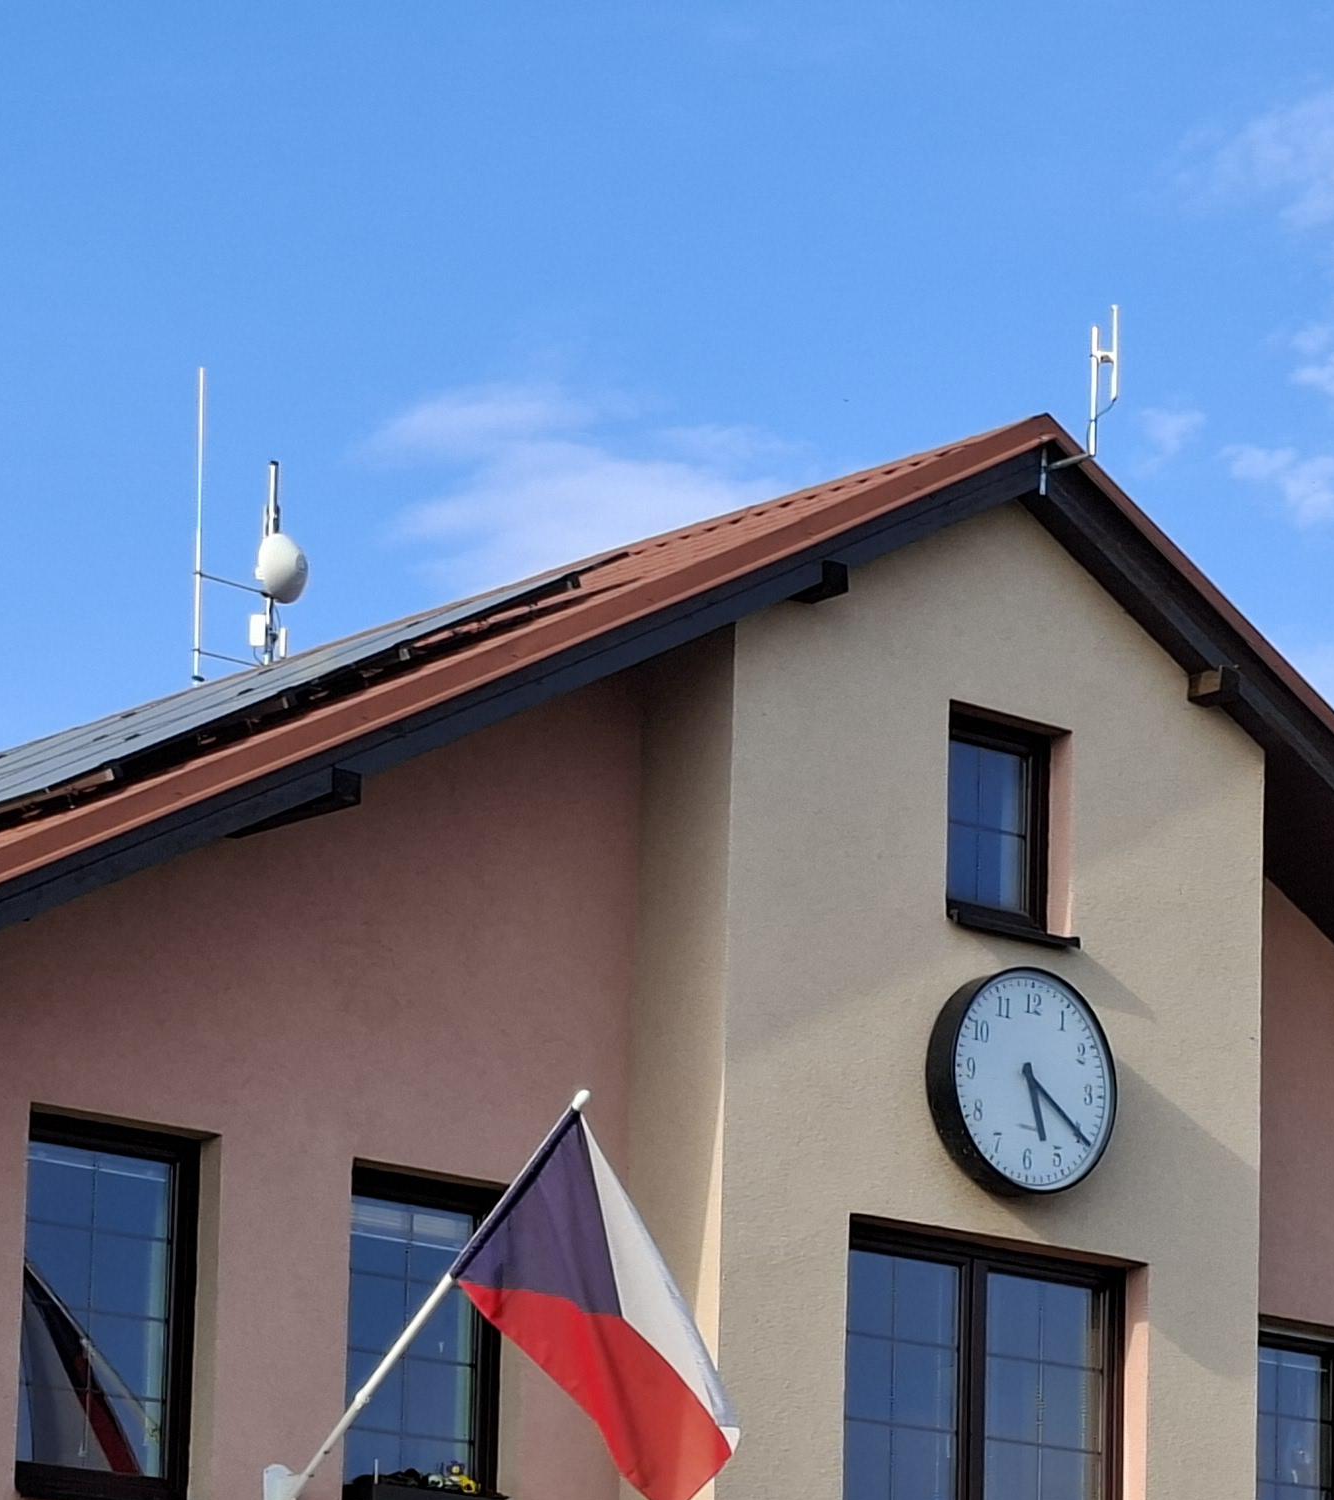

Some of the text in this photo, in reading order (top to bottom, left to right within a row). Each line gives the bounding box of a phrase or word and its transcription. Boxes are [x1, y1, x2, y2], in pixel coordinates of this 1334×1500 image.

[996, 996, 1011, 1018] 11
[1026, 993, 1042, 1016] 12
[972, 1020, 989, 1042] 10
[1058, 1010, 1065, 1031] 1
[1077, 1043, 1086, 1065] 2
[967, 1057, 976, 1079] 9
[1083, 1084, 1093, 1106] 3
[973, 1099, 983, 1121] 8
[993, 1132, 1002, 1154] 7
[1022, 1148, 1032, 1170] 6
[1053, 1145, 1062, 1167] 5
